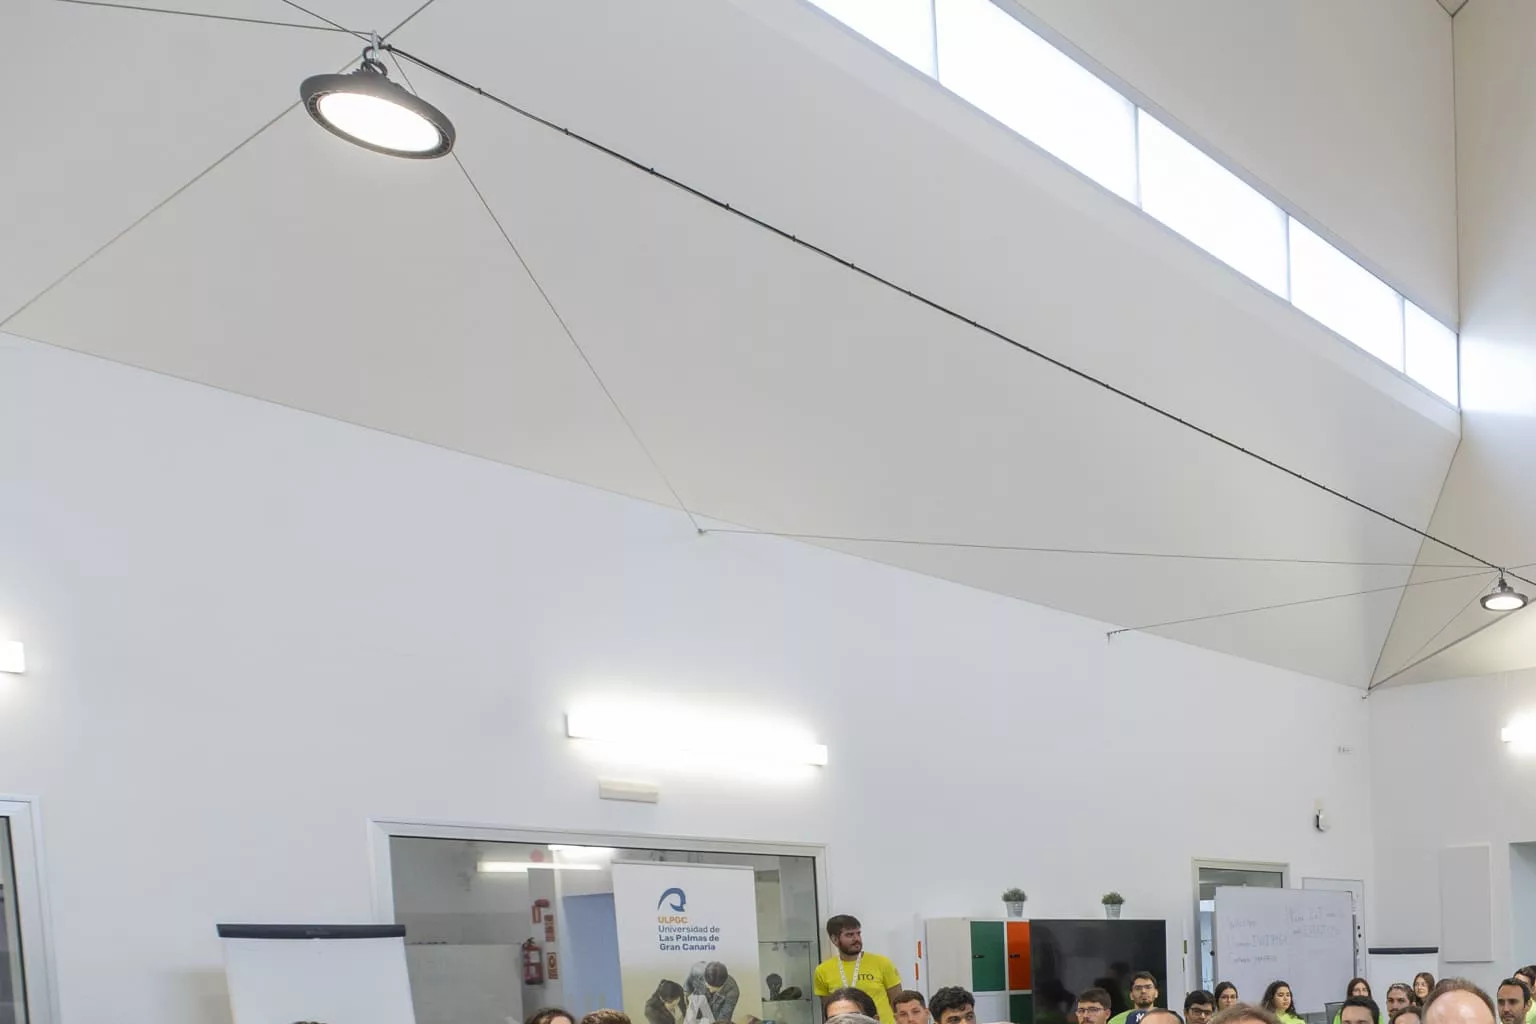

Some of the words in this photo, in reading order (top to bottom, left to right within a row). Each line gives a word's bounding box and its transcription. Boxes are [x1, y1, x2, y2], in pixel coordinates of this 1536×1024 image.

[658, 916, 688, 924] ULPGC
[658, 925, 708, 933] Universidad
[659, 934, 674, 942] Las
[675, 934, 708, 942] Palmas
[709, 934, 720, 942] de
[660, 943, 681, 951] Gran
[682, 943, 716, 951] Canaria
